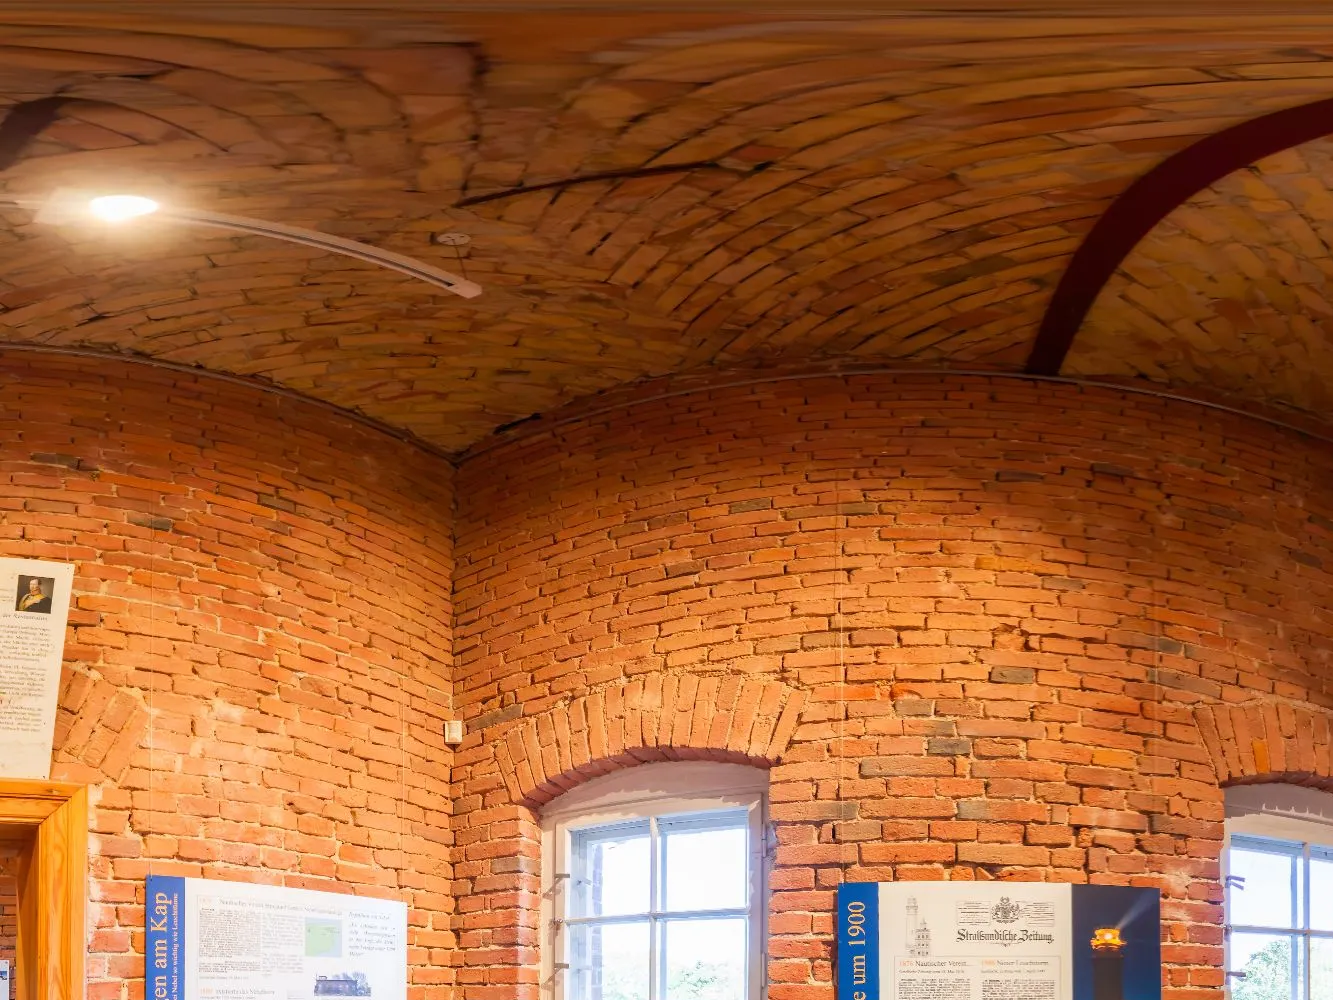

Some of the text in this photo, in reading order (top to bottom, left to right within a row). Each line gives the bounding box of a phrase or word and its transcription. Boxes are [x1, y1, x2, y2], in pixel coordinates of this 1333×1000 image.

[150, 892, 172, 932] Kap
[847, 901, 866, 946] 1900
[155, 938, 167, 968] am
[854, 954, 866, 985] um
